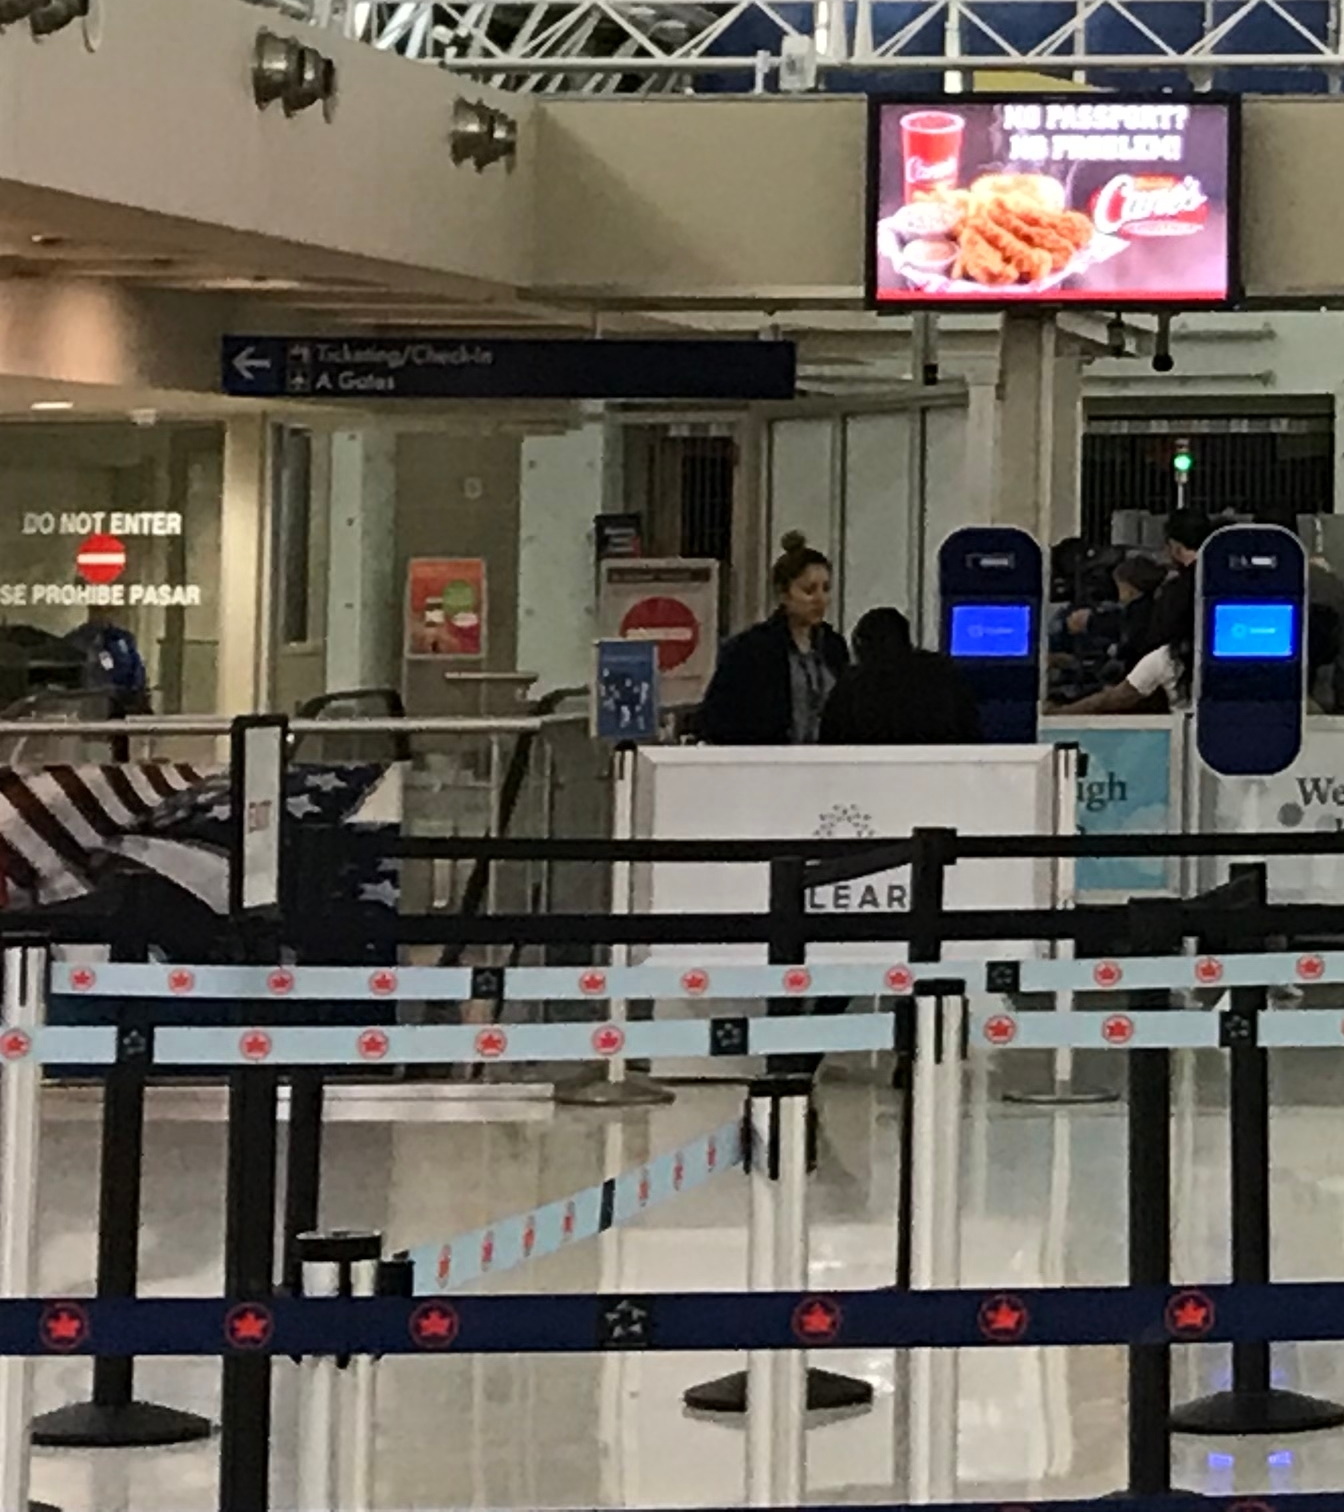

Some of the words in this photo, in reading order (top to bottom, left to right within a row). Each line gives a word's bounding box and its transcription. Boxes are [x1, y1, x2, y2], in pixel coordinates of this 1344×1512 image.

[315, 372, 332, 389] A
[338, 372, 394, 389] Gates
[22, 512, 54, 535] DO
[60, 511, 106, 535] NOT
[110, 511, 183, 536] ENTER
[0, 584, 27, 606] SE
[32, 584, 125, 606] PROHIBE
[129, 584, 200, 606] PASAR
[808, 884, 907, 909] LEAR
